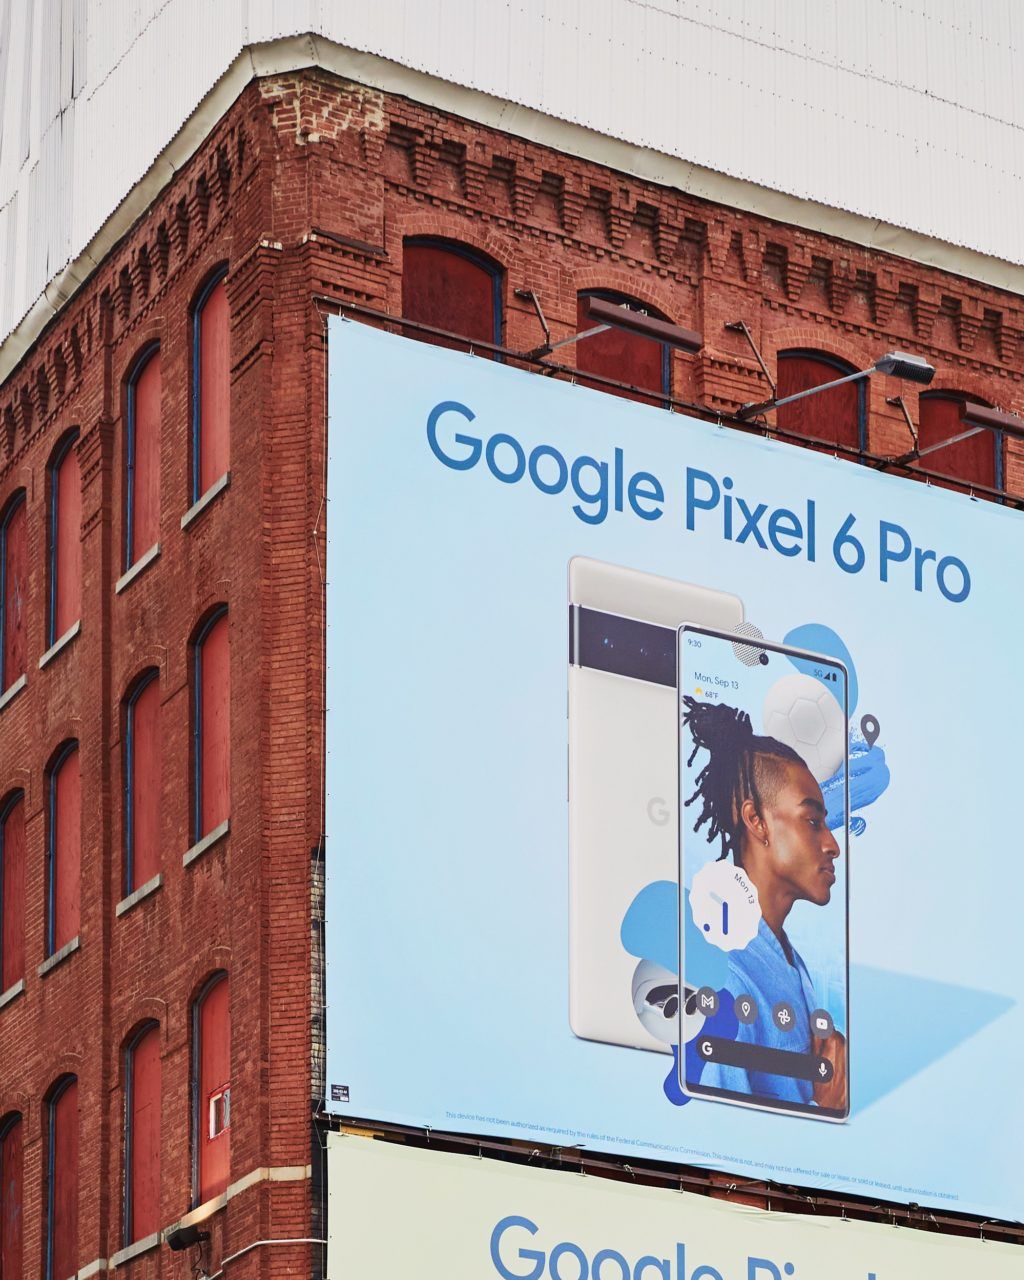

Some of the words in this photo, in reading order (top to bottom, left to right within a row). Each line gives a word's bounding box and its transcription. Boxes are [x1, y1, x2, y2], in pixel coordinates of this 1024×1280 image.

[426, 400, 665, 525] Google
[686, 467, 816, 563] Pixel
[832, 513, 866, 575] 6
[879, 519, 971, 603] Pro
[687, 638, 702, 648] 9:30
[813, 668, 823, 677] 5G
[714, 676, 730, 688] Sep
[731, 680, 739, 690] 13
[647, 796, 671, 827] G
[734, 873, 749, 892] Mon
[747, 894, 755, 904] 13
[701, 1041, 713, 1056] G
